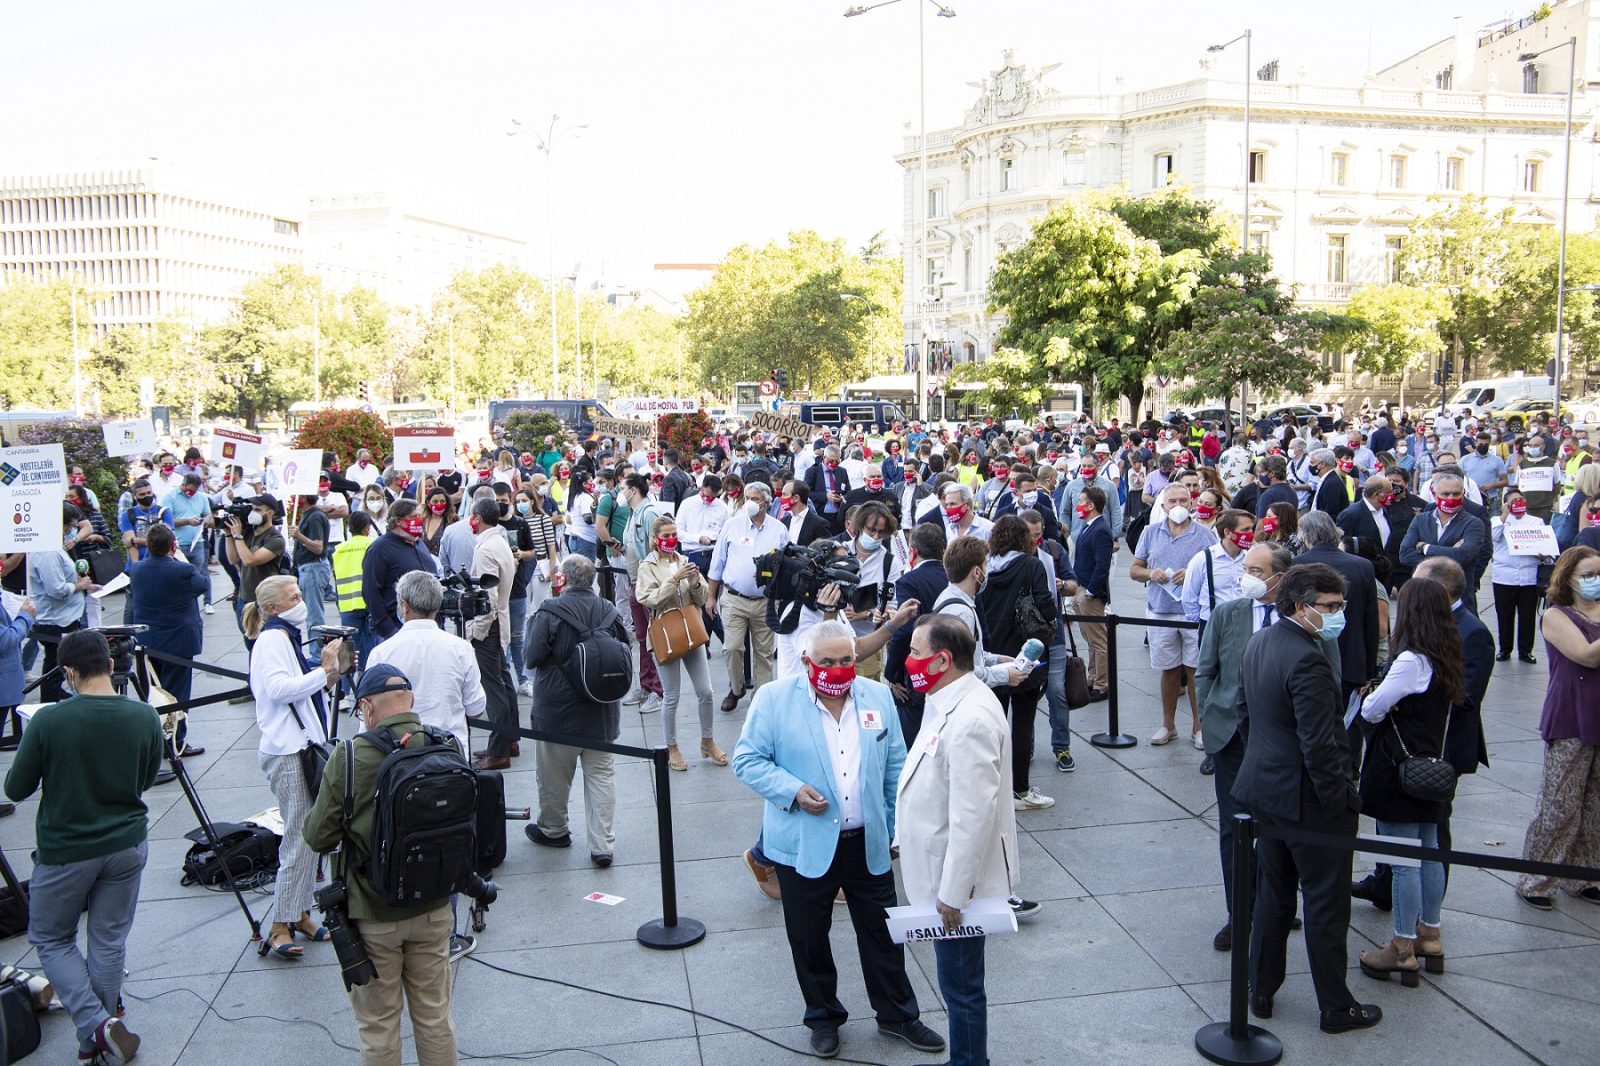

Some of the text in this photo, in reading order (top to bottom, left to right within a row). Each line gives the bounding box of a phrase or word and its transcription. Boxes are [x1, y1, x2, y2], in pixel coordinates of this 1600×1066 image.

[635, 402, 647, 410] ALA
[648, 402, 657, 410] DE
[682, 401, 694, 410] PUB
[595, 420, 618, 435] CIERRE
[751, 411, 812, 441] SOCORRO!
[5, 448, 40, 456] CANTABRIA
[20, 459, 54, 471] HOSTELERÍA
[21, 470, 61, 482] DE CANTABRIA
[12, 488, 41, 497] ZARAGOZA
[905, 925, 985, 939] #SALVEMOS
